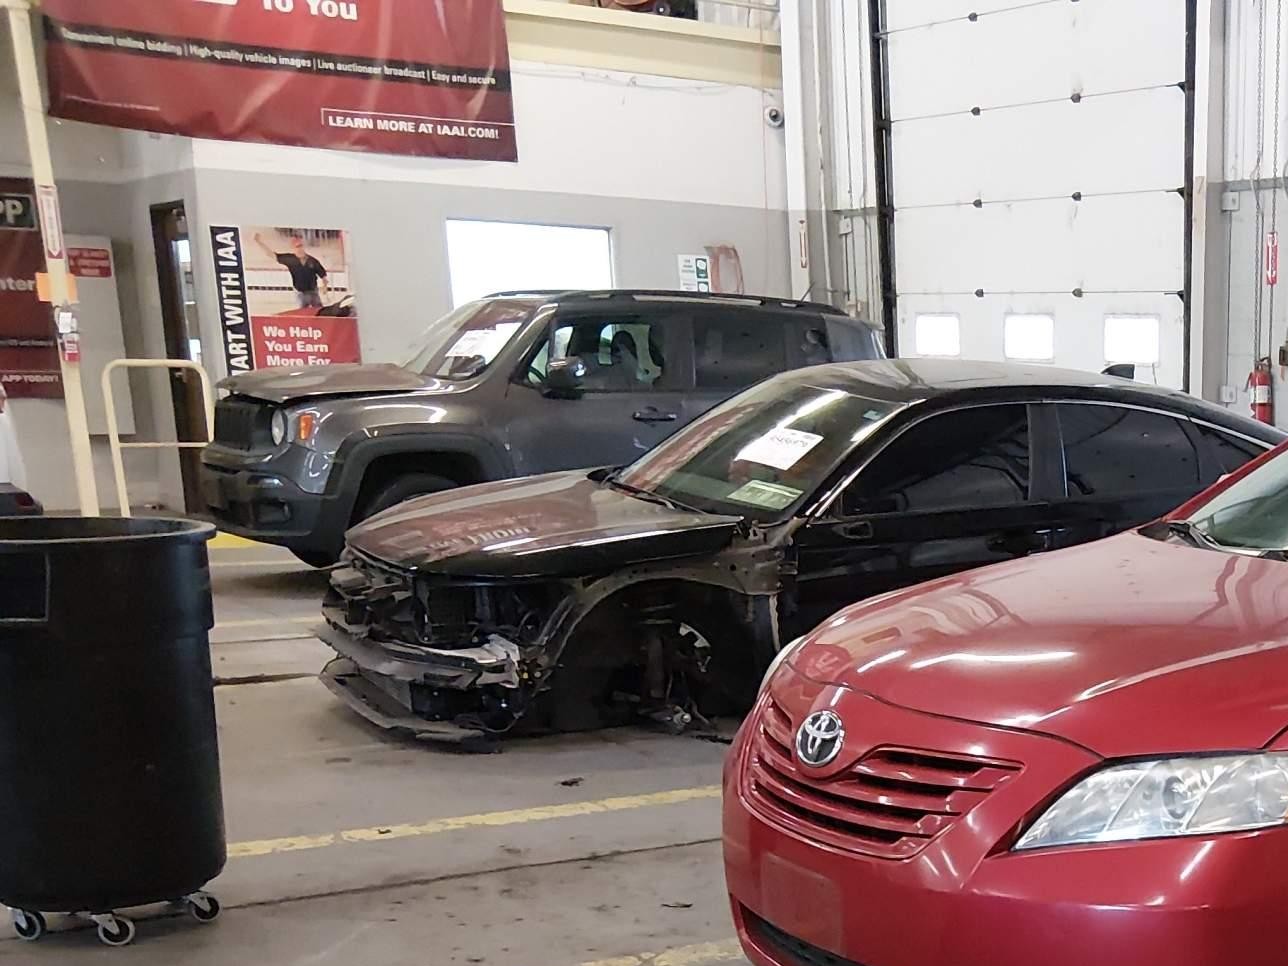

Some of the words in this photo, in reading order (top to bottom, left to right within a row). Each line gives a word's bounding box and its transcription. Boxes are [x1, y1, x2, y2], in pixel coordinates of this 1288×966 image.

[306, 0, 358, 20] You
[189, 44, 243, 62] High-quality
[245, 53, 277, 64] vehicle
[279, 55, 311, 68] images
[317, 59, 335, 70] Live
[336, 62, 382, 75] auctioneer
[383, 65, 426, 79] broadcast
[431, 70, 450, 83] Easy
[451, 74, 467, 83] and
[468, 76, 496, 84] secure
[328, 115, 373, 129] LEARN
[377, 119, 415, 133] MORE
[418, 123, 434, 134] AT
[437, 124, 500, 139] IAAI.COM!
[215, 231, 239, 266] IAA
[219, 272, 245, 326] WITH
[262, 325, 286, 337] We
[289, 326, 322, 340] Help
[264, 340, 292, 352] You
[295, 340, 329, 353] Earn
[266, 354, 304, 367] More
[307, 355, 331, 366] For
